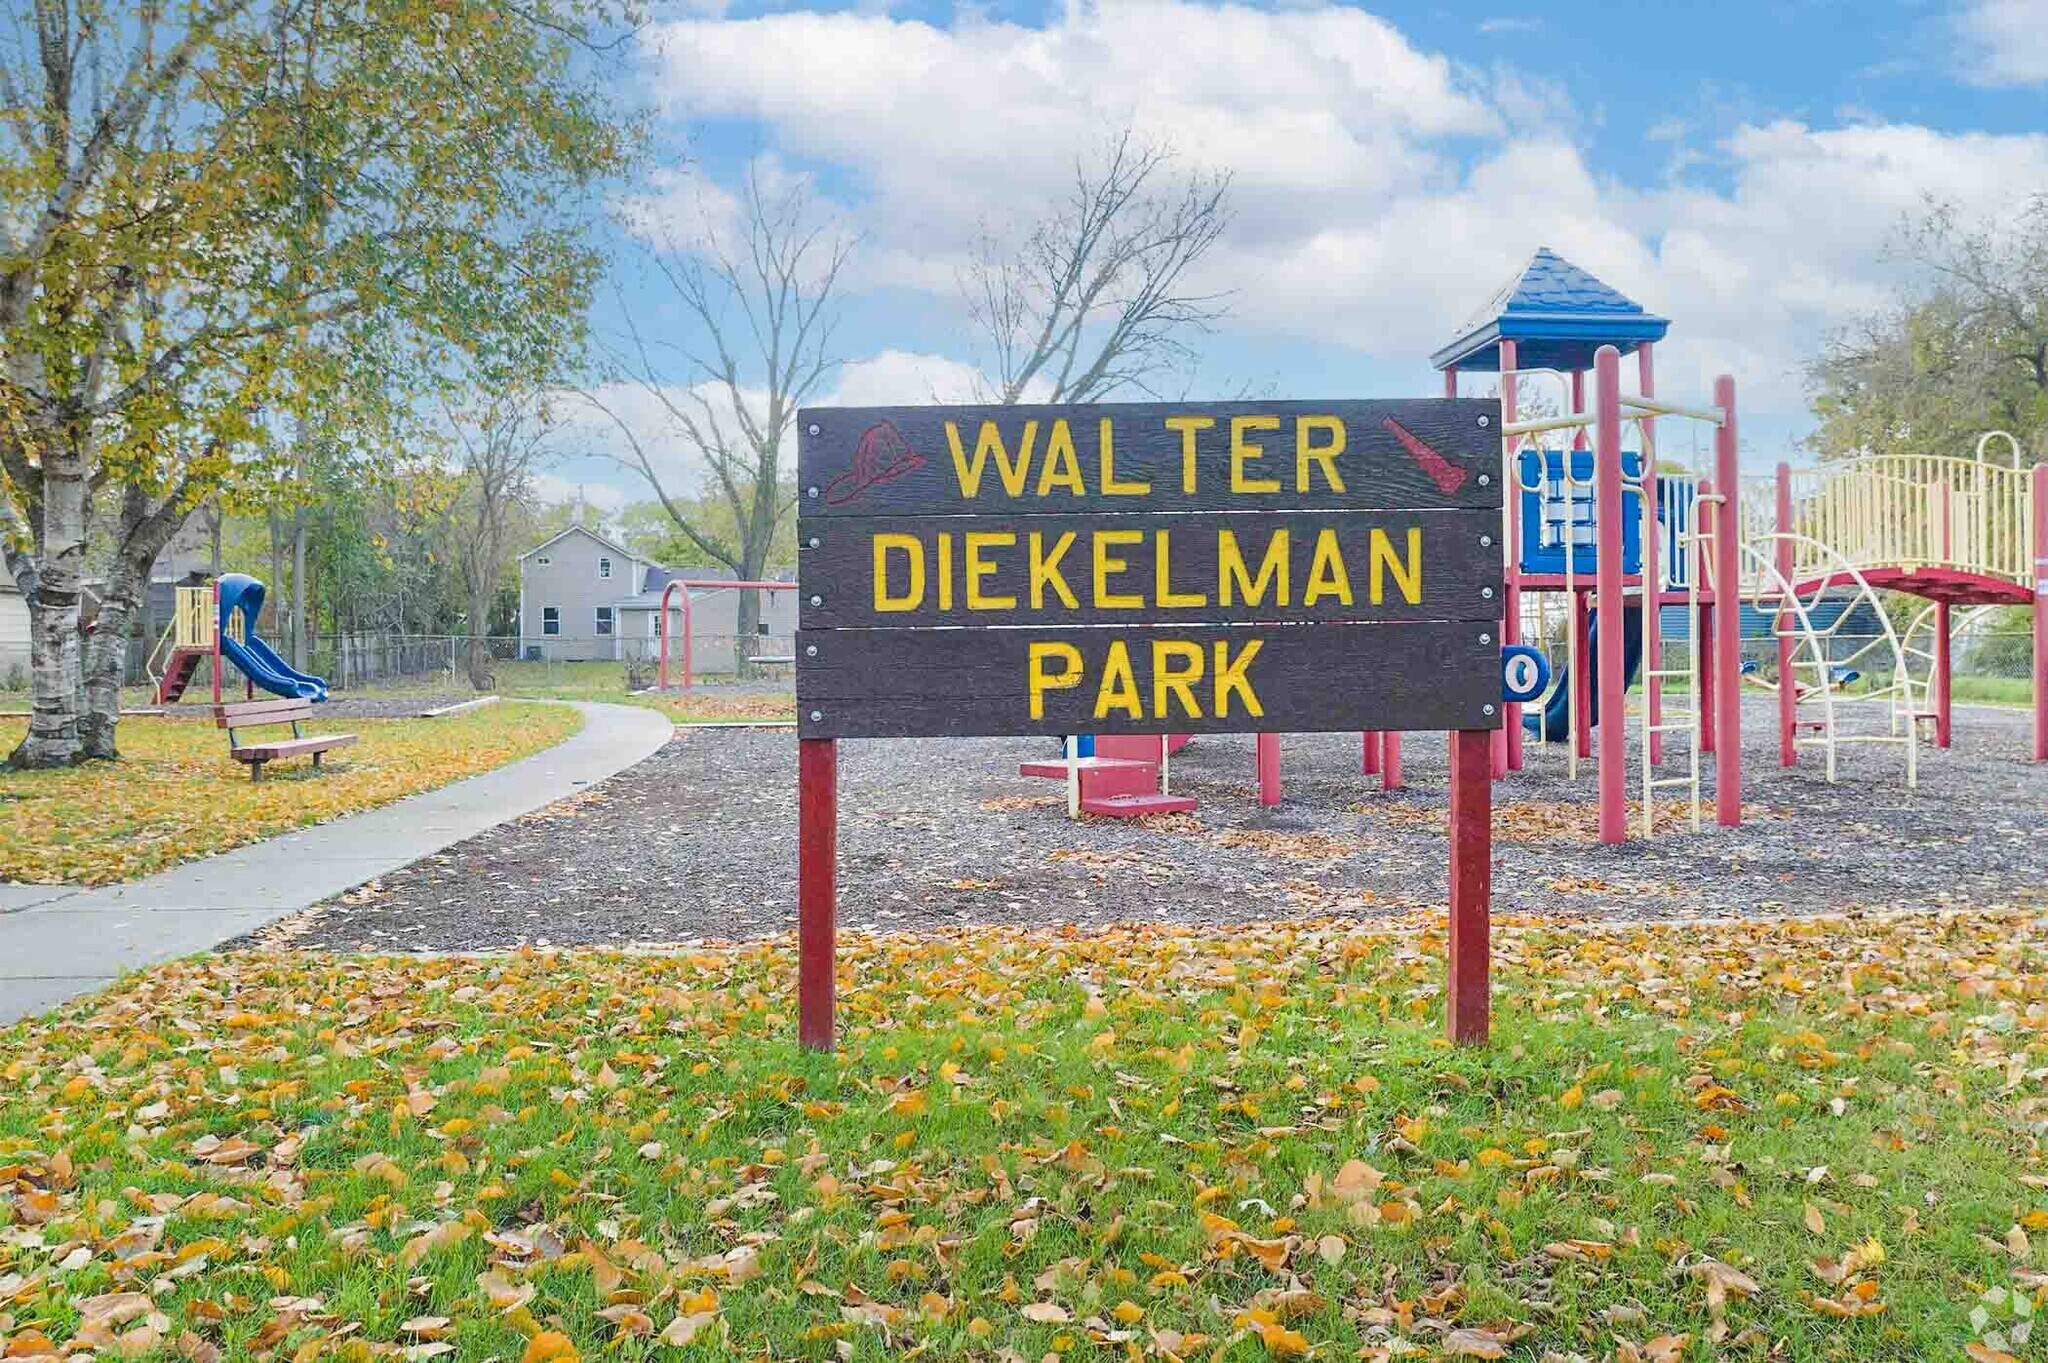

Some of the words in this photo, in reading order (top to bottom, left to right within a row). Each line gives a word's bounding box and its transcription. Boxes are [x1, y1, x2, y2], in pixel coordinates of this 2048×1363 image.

[943, 415, 1347, 498] WALTER
[872, 527, 1423, 612] DIEKELMAN
[1027, 637, 1265, 720] PARK
